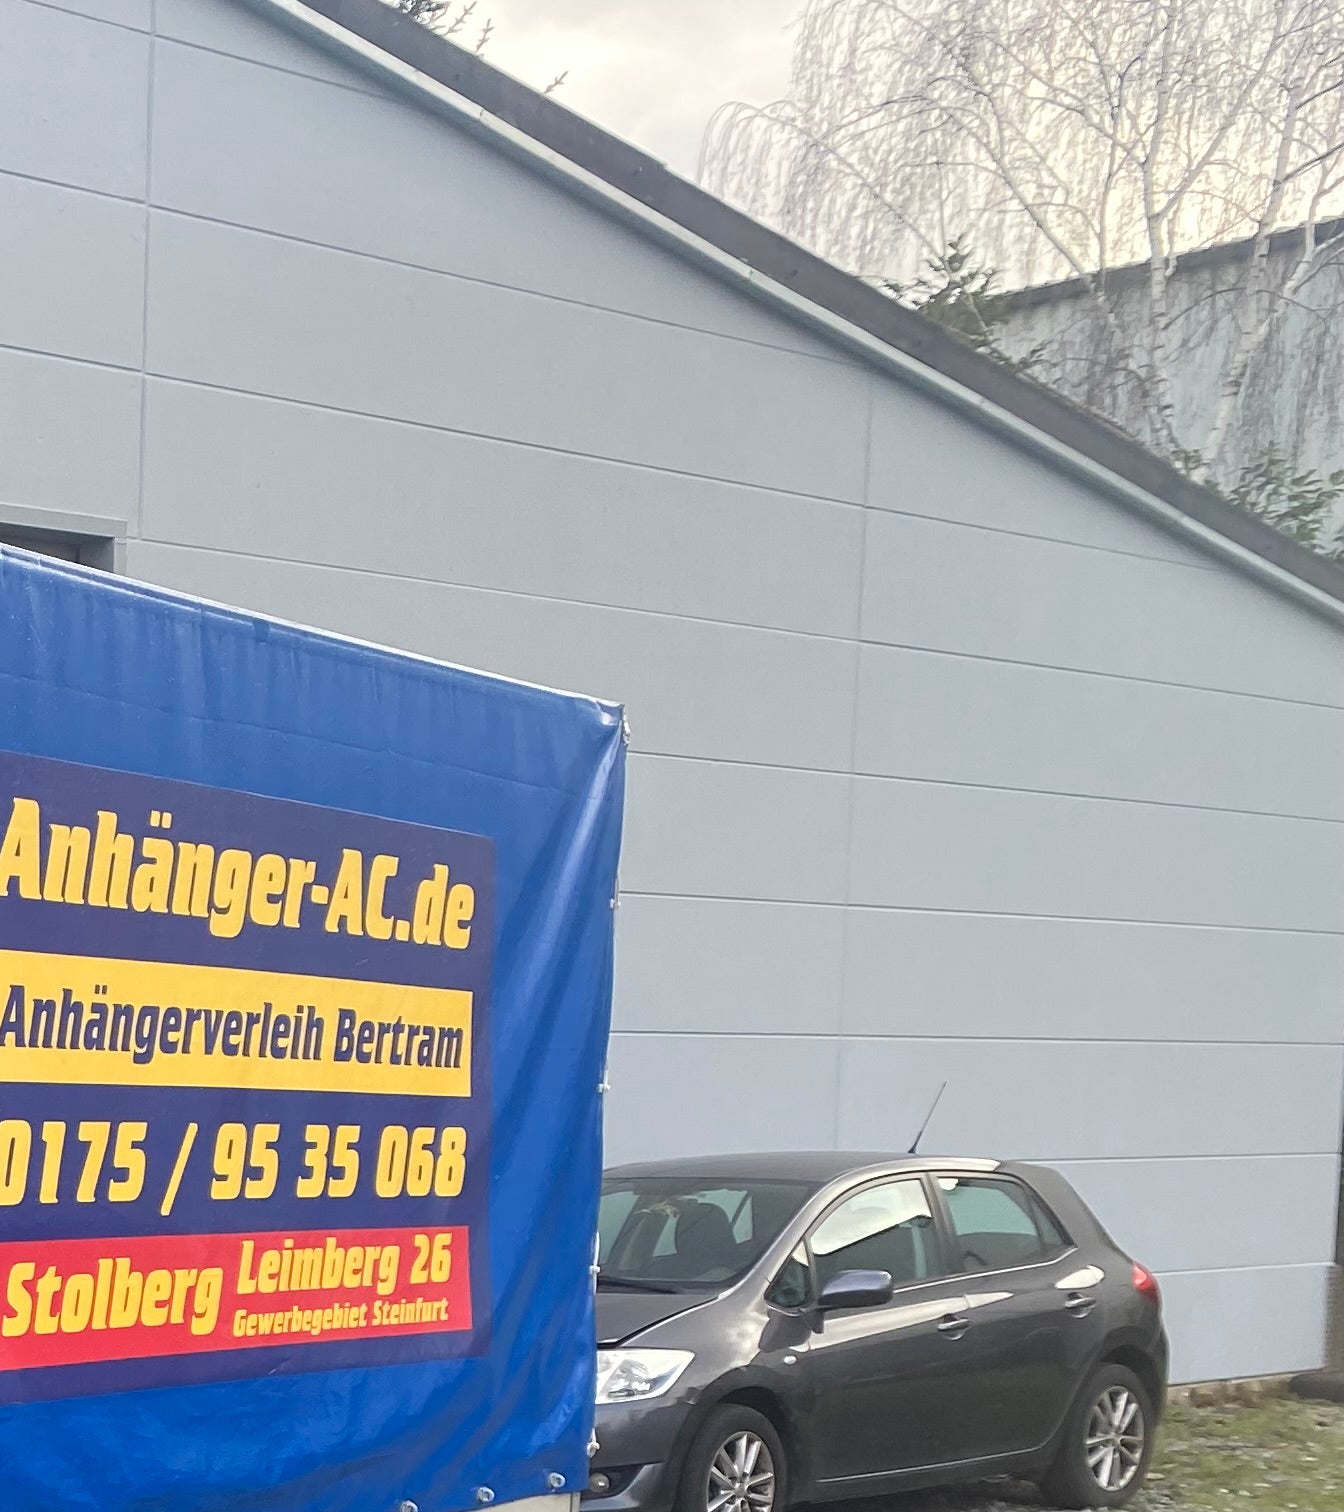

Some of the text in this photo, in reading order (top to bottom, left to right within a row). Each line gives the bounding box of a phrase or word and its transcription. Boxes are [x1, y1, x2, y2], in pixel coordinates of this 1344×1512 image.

[333, 1008, 463, 1068] Bertram
[160, 1122, 198, 1216] /
[210, 1123, 280, 1199] 95
[296, 1124, 360, 1198] 35
[375, 1126, 467, 1198] 068
[1, 1233, 452, 1337] Stolberg Leimberg 26
[232, 1297, 449, 1338] Gewerbegebiet Steinfurt
